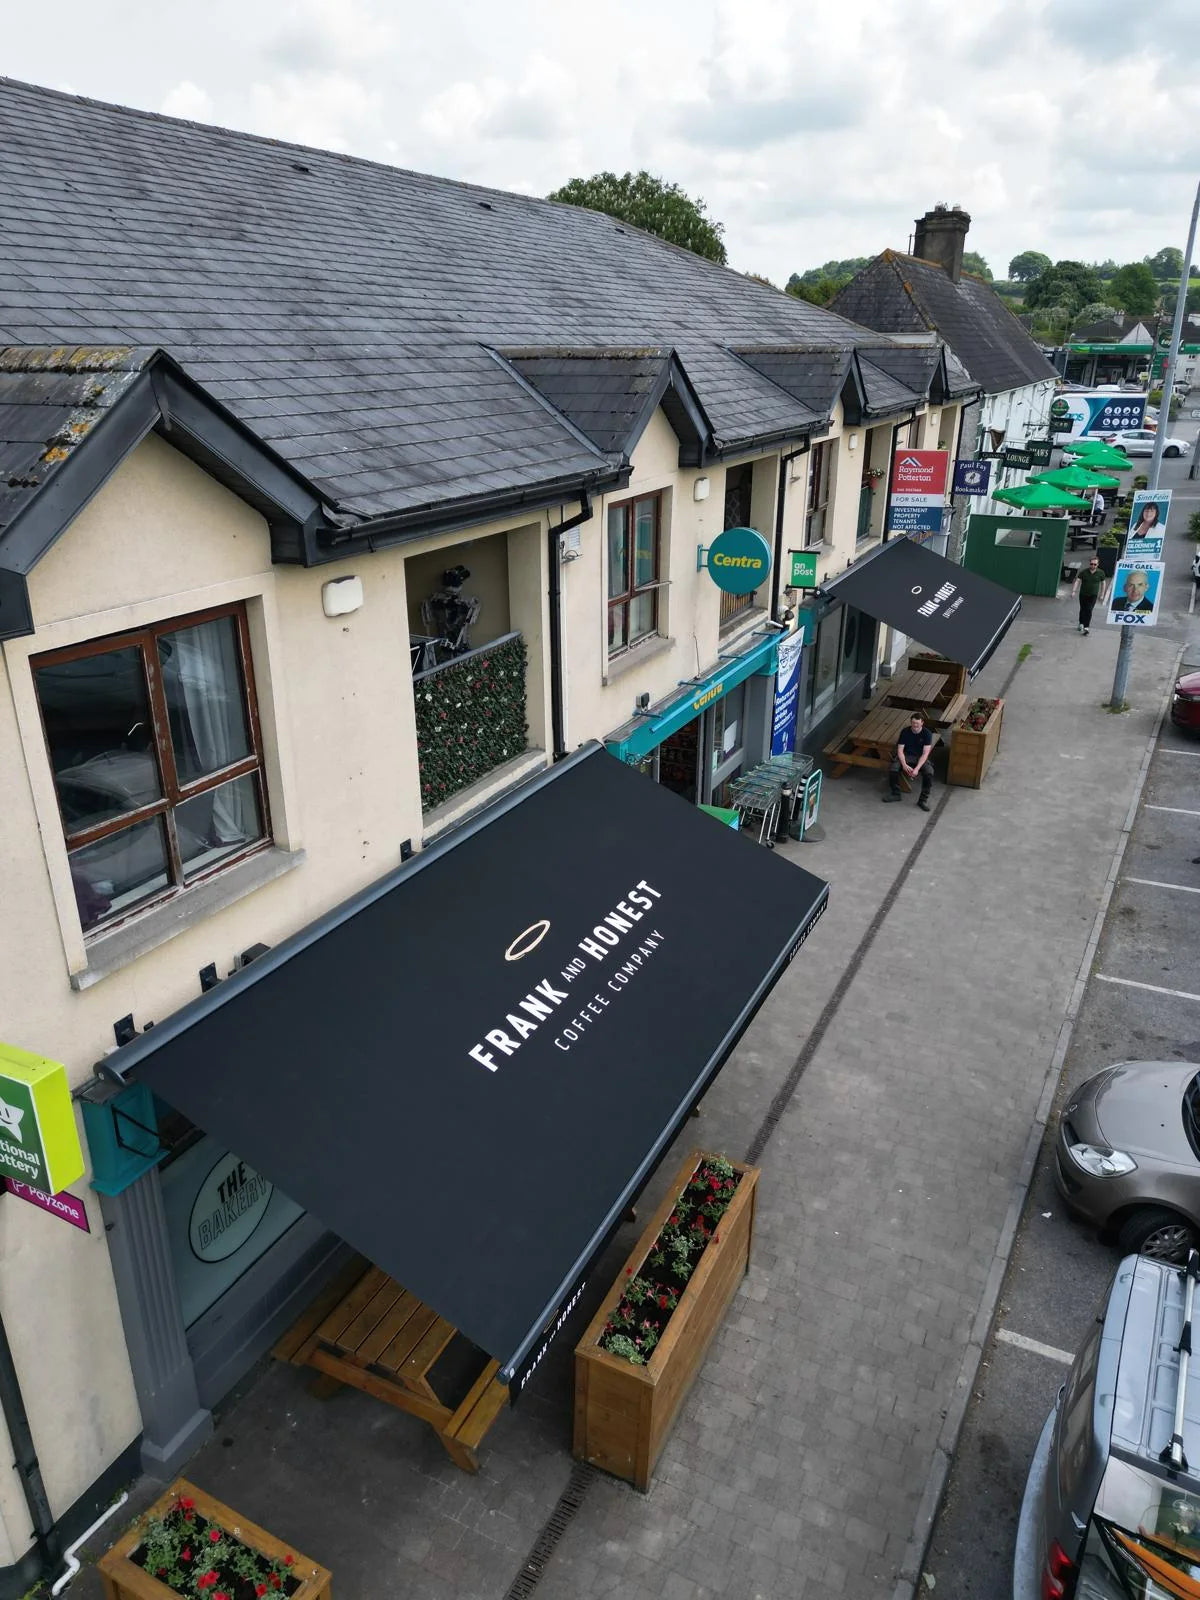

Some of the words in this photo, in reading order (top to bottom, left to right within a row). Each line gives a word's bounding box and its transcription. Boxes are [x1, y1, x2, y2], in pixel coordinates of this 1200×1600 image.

[976, 462, 987, 471] Fay
[1007, 454, 1030, 464] LOUNGE
[897, 474, 932, 482] Potterton
[899, 466, 934, 474] Raymond
[955, 486, 987, 494] Bookmaker
[713, 553, 762, 569] Centra
[793, 568, 814, 576] post
[917, 600, 940, 617] FRANK
[1115, 613, 1145, 624] FOX
[468, 978, 569, 1073] FRANK
[560, 957, 586, 983] AND
[578, 879, 662, 961] HONEST
[554, 993, 610, 1051] COFFEE
[607, 929, 665, 992] COMPANY
[0, 1139, 41, 1166] tional
[217, 1161, 248, 1204] THE
[28, 1184, 80, 1219] Payzone
[198, 1174, 267, 1251] BAKERY
[521, 1342, 548, 1390] FRANK
[557, 1281, 586, 1331] HONEST
